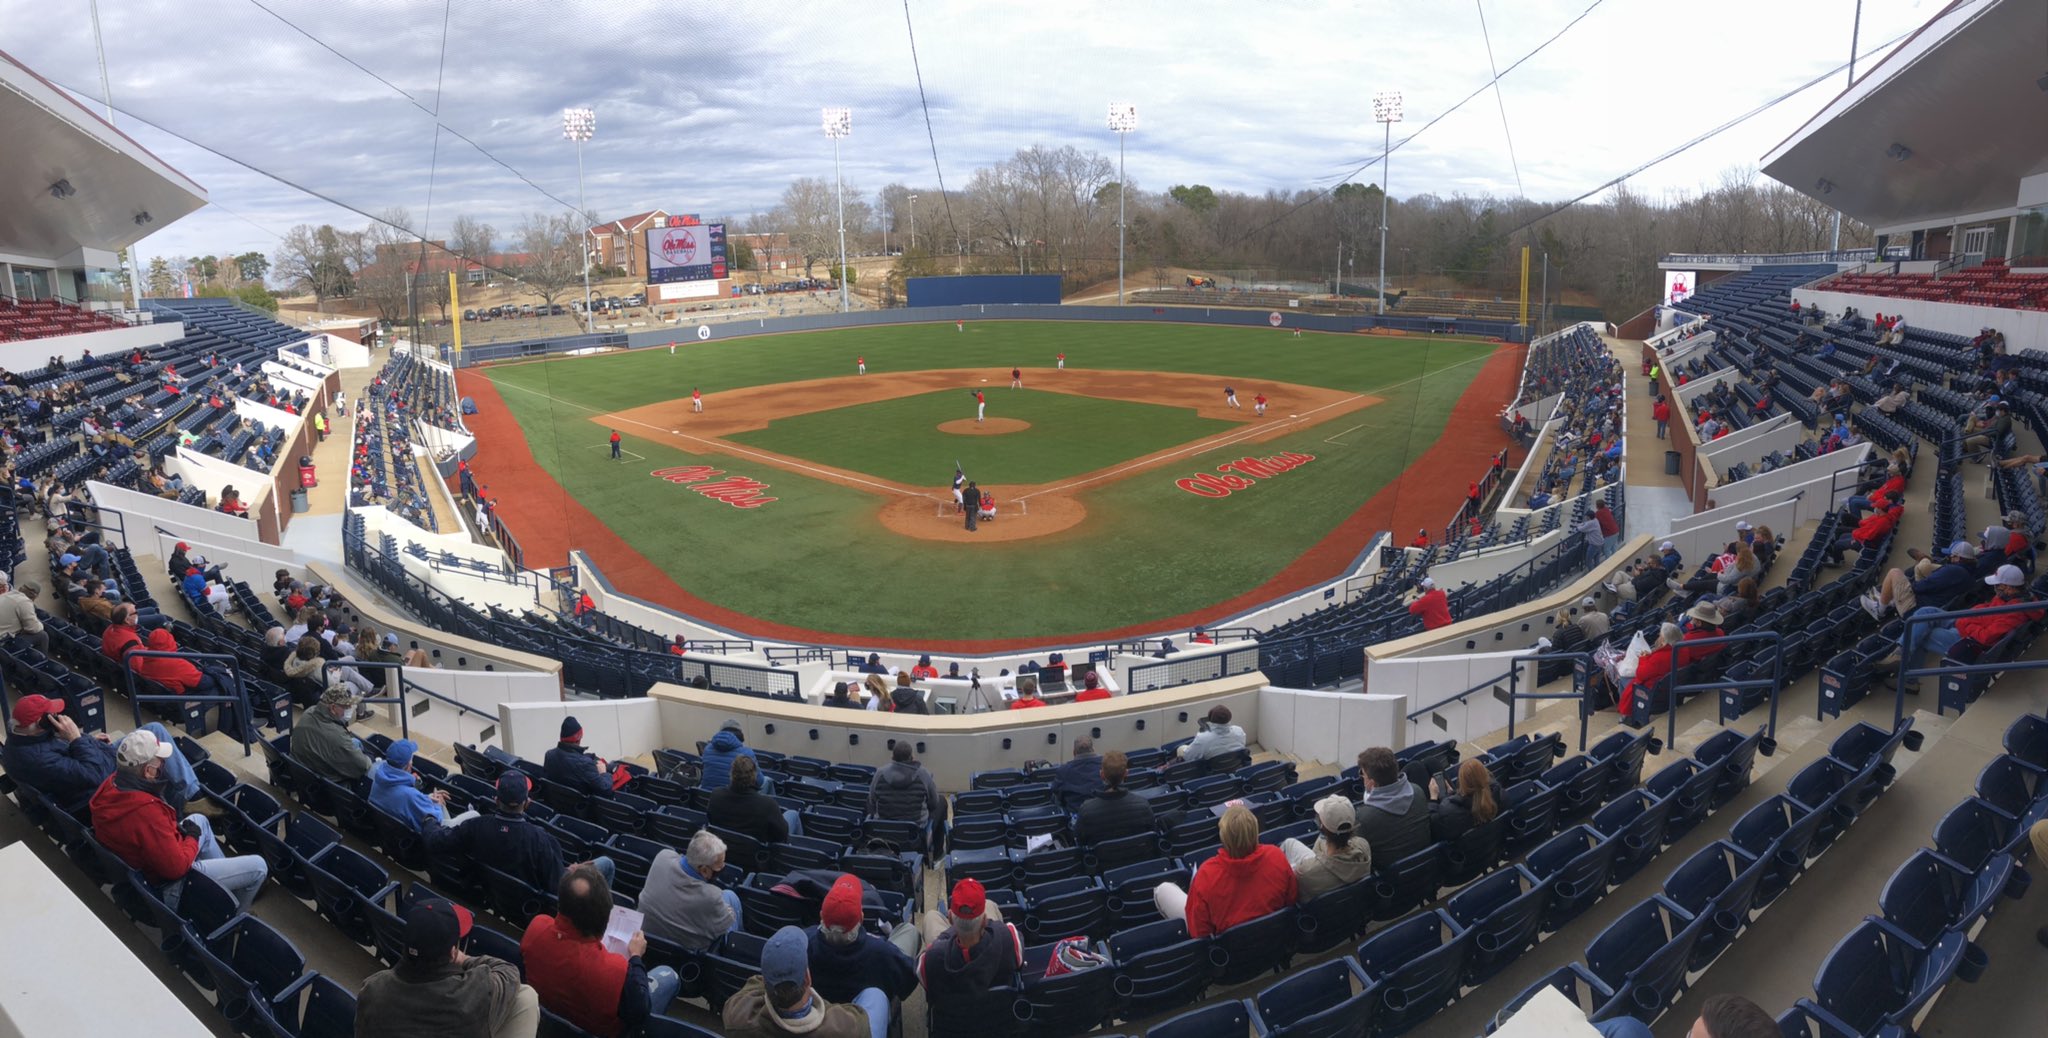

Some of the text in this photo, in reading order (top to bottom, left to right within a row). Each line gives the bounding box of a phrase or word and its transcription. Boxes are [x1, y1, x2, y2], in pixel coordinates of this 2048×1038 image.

[663, 238, 695, 250] Ole Miss
[650, 466, 779, 509] Ole Miss
[1175, 451, 1316, 498] Ole Miss
